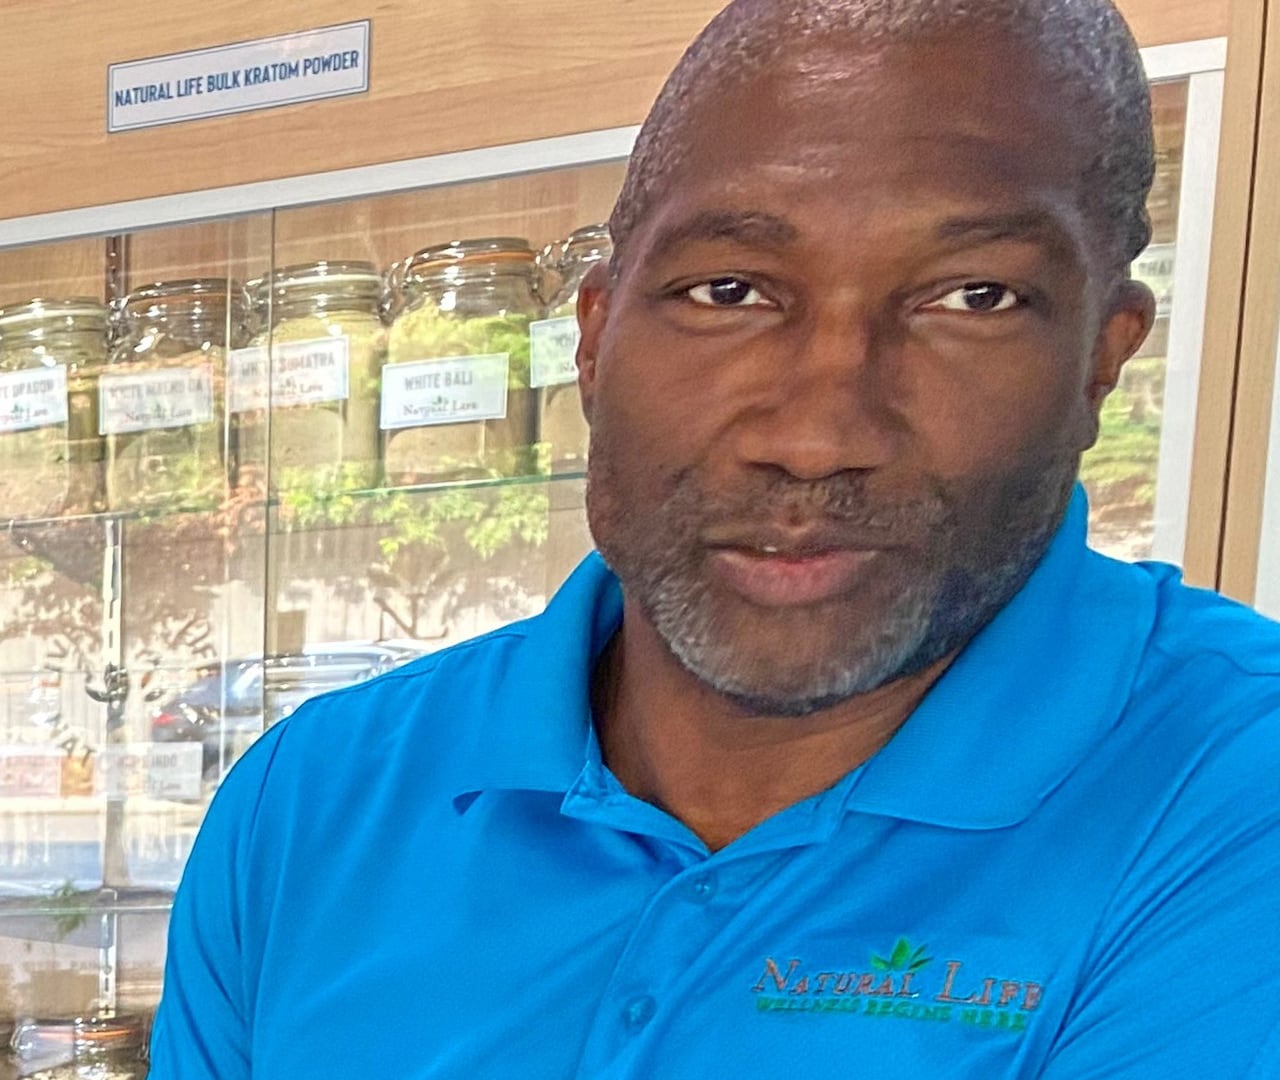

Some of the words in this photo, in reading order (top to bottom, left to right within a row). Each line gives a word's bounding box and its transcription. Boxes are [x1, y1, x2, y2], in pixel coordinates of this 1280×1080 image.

[115, 82, 173, 107] NATURAL
[177, 76, 203, 98] LIFE
[207, 71, 240, 93] BULK
[244, 60, 300, 88] KRATOM
[303, 50, 359, 76] POWDER
[405, 373, 441, 390] WHITE
[444, 371, 473, 387] BALI
